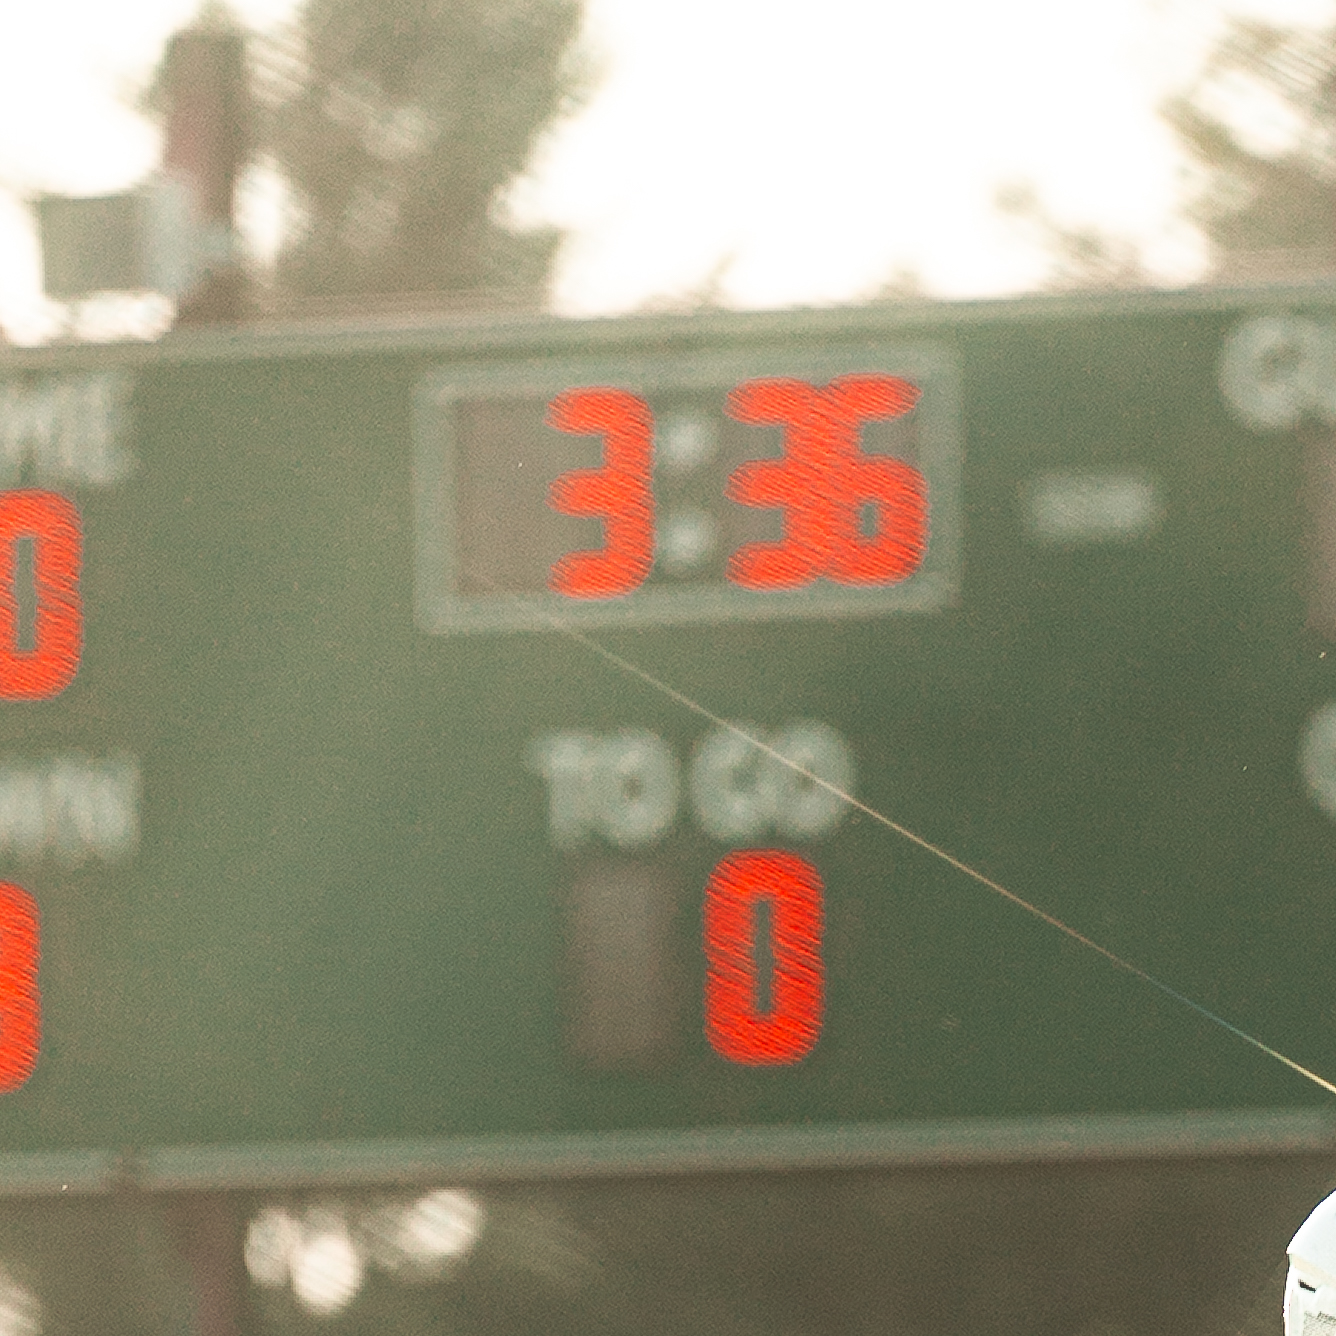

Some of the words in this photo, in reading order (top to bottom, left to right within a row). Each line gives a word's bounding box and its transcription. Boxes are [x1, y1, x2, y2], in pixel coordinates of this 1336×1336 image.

[545, 373, 931, 600] 3:36
[526, 728, 680, 855] TO
[690, 720, 856, 842] GO
[705, 850, 825, 1066] 0
